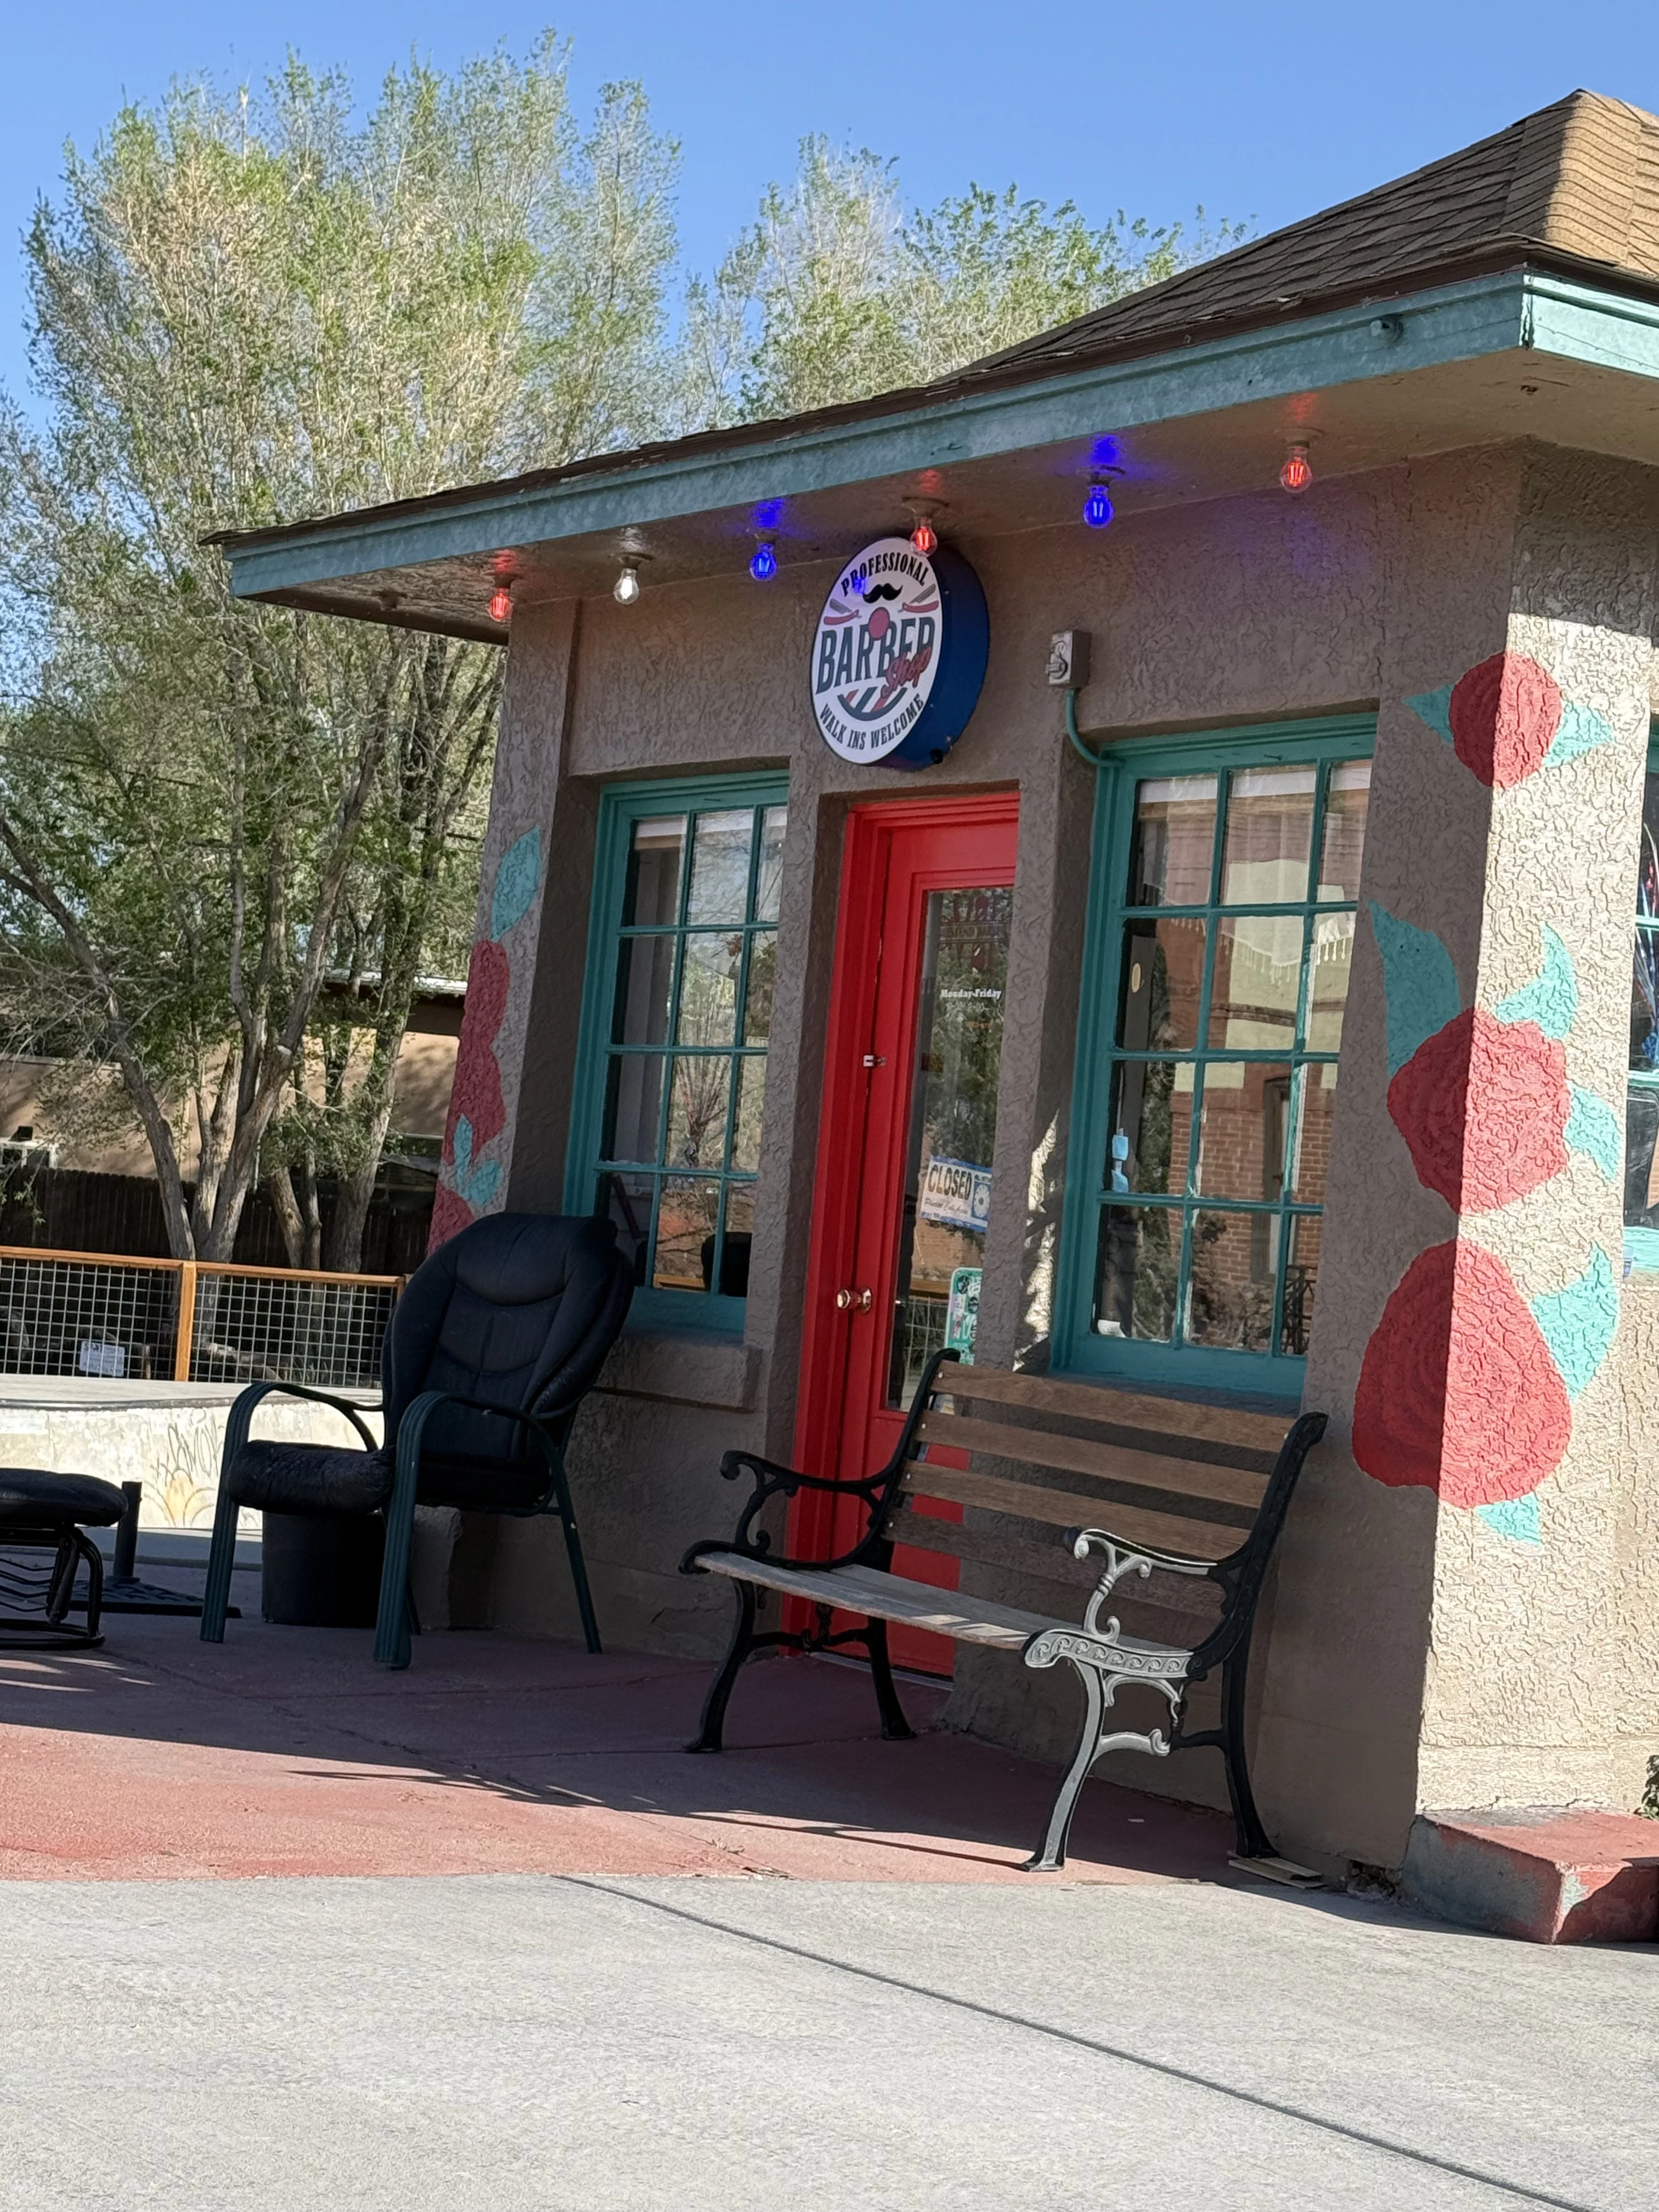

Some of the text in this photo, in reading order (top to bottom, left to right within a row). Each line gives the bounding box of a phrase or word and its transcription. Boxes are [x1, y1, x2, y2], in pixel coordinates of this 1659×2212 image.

[840, 551, 929, 597] PROFESSIONAL
[815, 616, 935, 695] BARBER
[880, 647, 932, 698] Shop
[820, 693, 924, 751] WALK INS WELCOME
[940, 988, 1002, 1000] Monday-Friday
[928, 1164, 972, 1200] CLOSED
